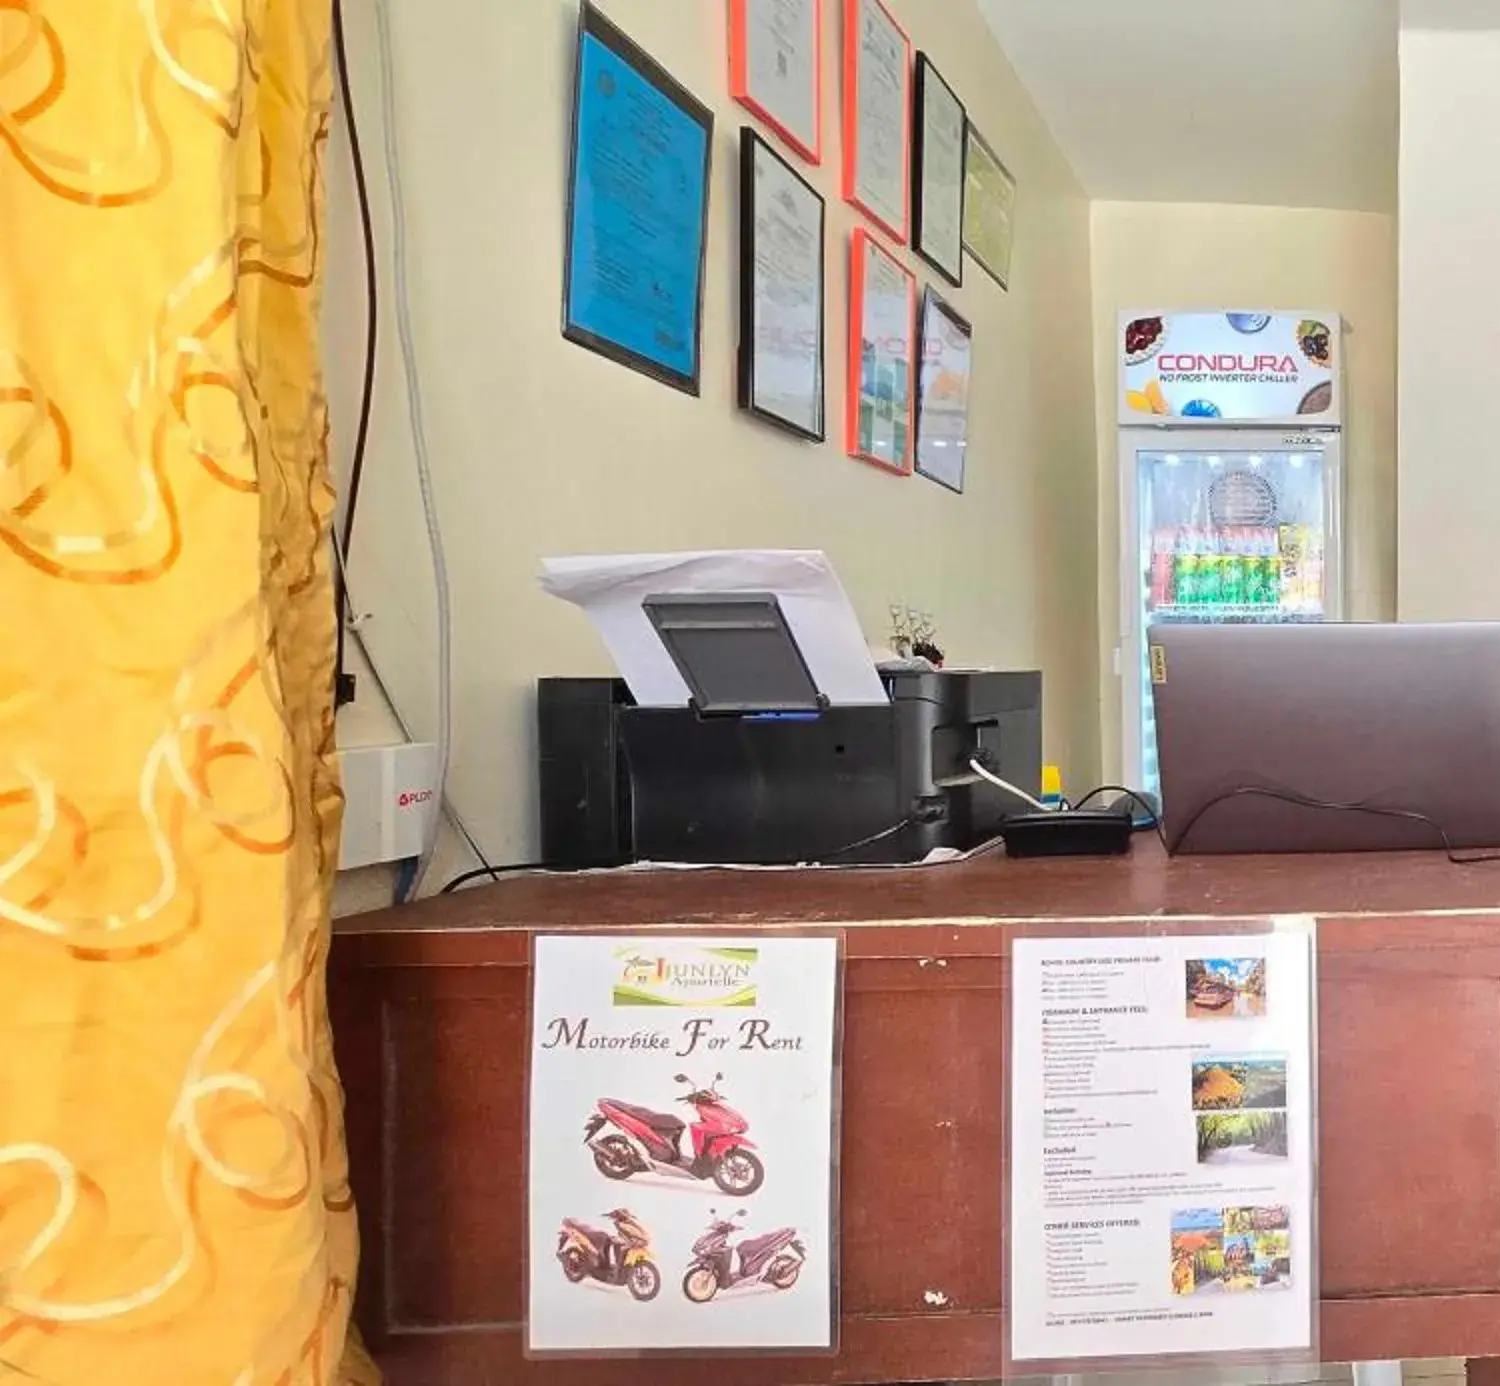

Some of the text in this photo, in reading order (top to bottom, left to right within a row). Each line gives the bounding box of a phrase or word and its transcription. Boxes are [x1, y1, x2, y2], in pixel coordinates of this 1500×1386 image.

[1158, 354, 1299, 373] CONDURA
[1159, 373, 1299, 383] NO FROST INVERTER CHILLER
[541, 1018, 803, 1058] Motorbike For Rent
